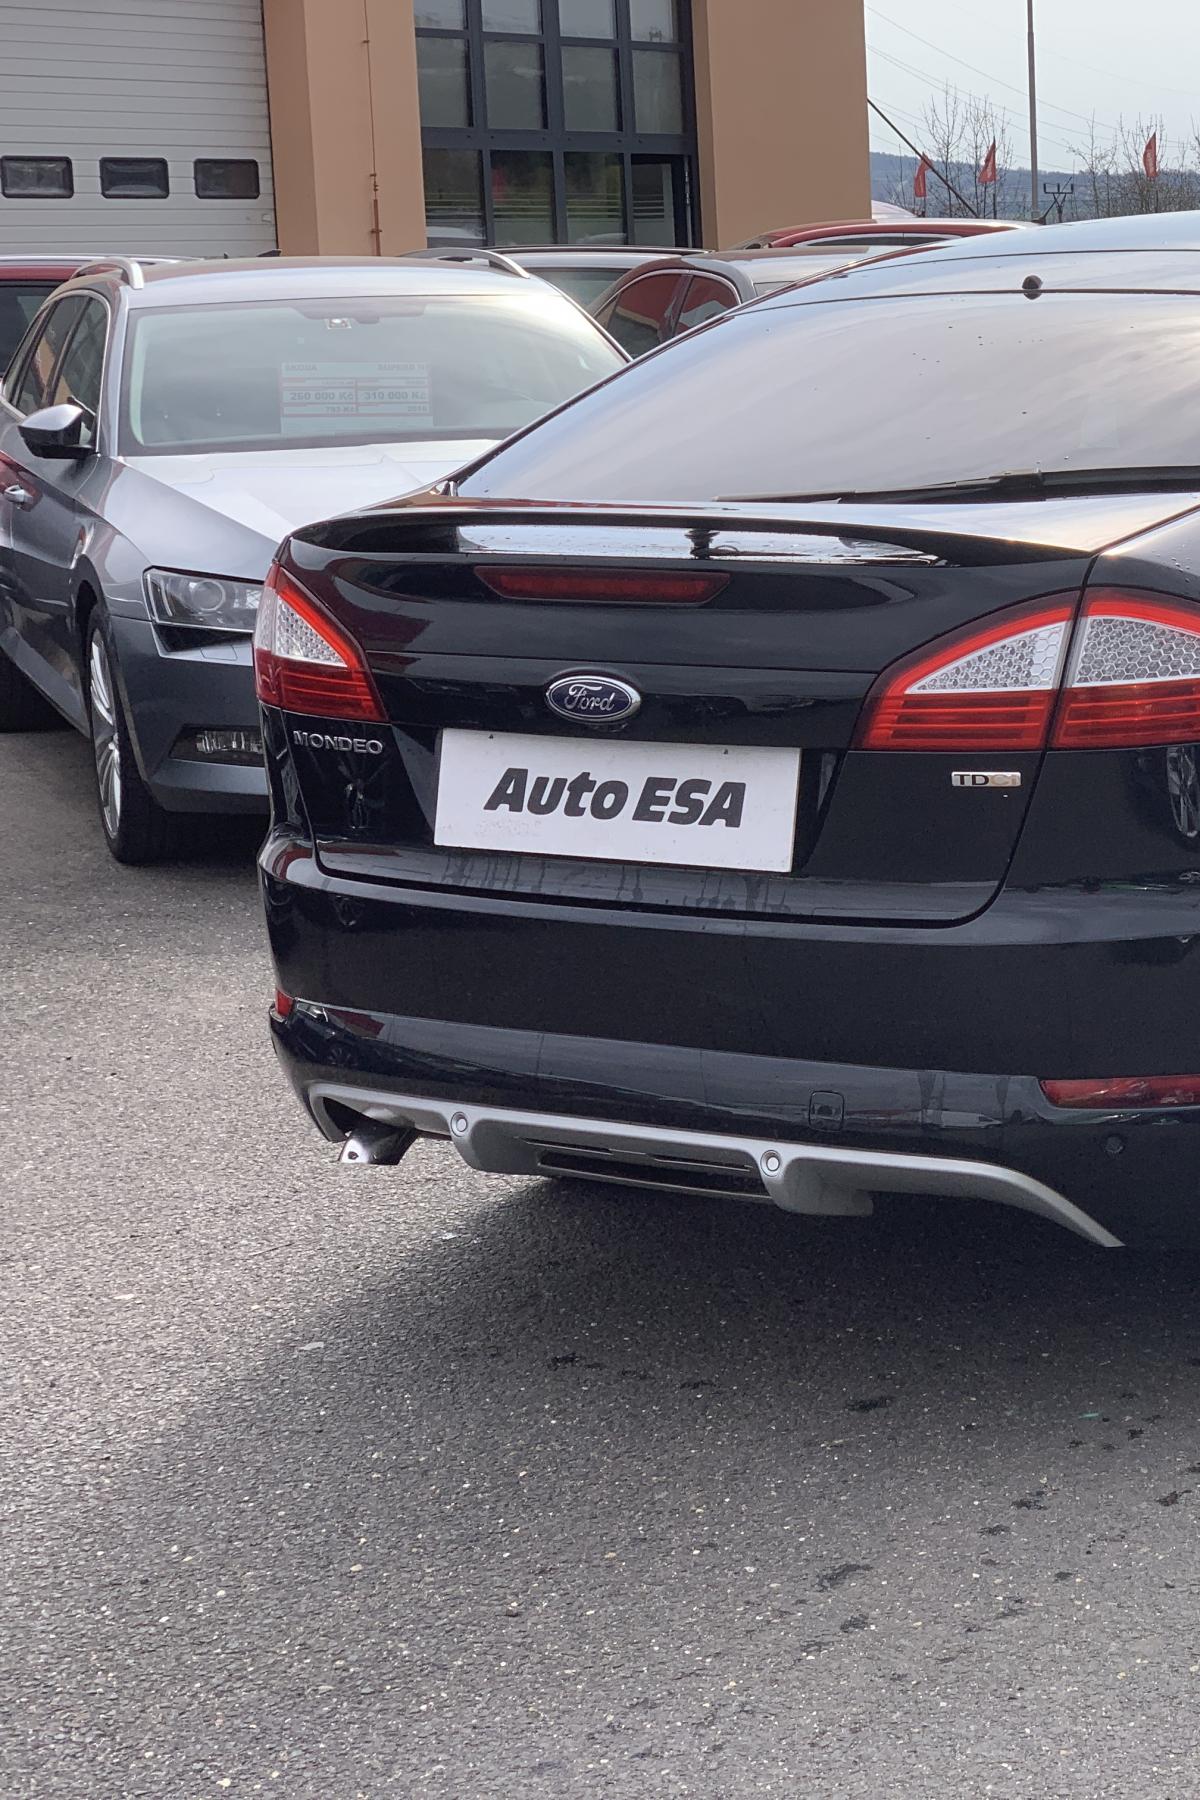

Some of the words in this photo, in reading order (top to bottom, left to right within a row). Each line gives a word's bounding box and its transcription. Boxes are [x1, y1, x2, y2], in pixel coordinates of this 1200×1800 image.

[563, 683, 616, 711] Ford
[293, 729, 383, 755] MONDEO
[483, 767, 629, 820] Auto
[632, 776, 747, 829] ESA
